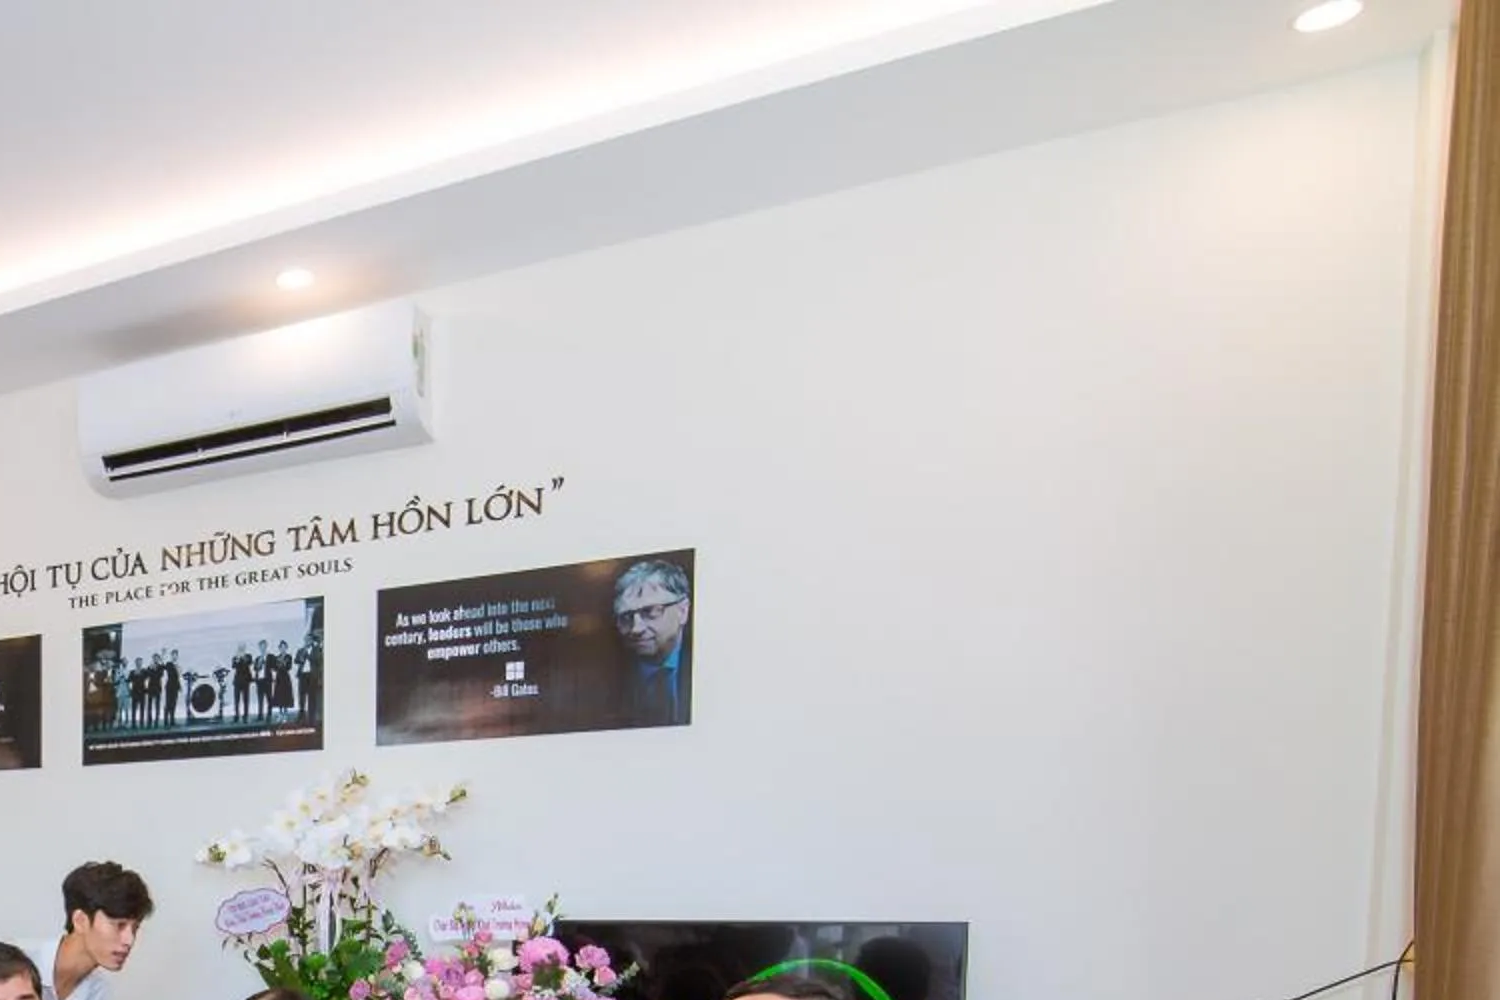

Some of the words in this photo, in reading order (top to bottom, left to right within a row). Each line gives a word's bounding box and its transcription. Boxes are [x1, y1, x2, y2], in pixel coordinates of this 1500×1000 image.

[46, 562, 83, 590] TỤ
[90, 547, 148, 581] CỦA
[160, 532, 276, 572] NHỮNG
[287, 516, 360, 552] TÂM
[371, 496, 453, 540] HỒN
[68, 594, 99, 609] THE
[105, 587, 153, 605] PLACE
[159, 581, 191, 597] FOR
[198, 574, 230, 591] THE
[235, 566, 292, 587] GREAT
[297, 558, 354, 579] SOULS
[395, 612, 409, 628] As
[412, 613, 427, 625] we
[428, 608, 452, 623] look
[453, 604, 485, 622] ahead
[428, 625, 473, 642] leaders
[474, 620, 493, 636] will
[495, 618, 509, 633] be
[427, 642, 480, 661] empower
